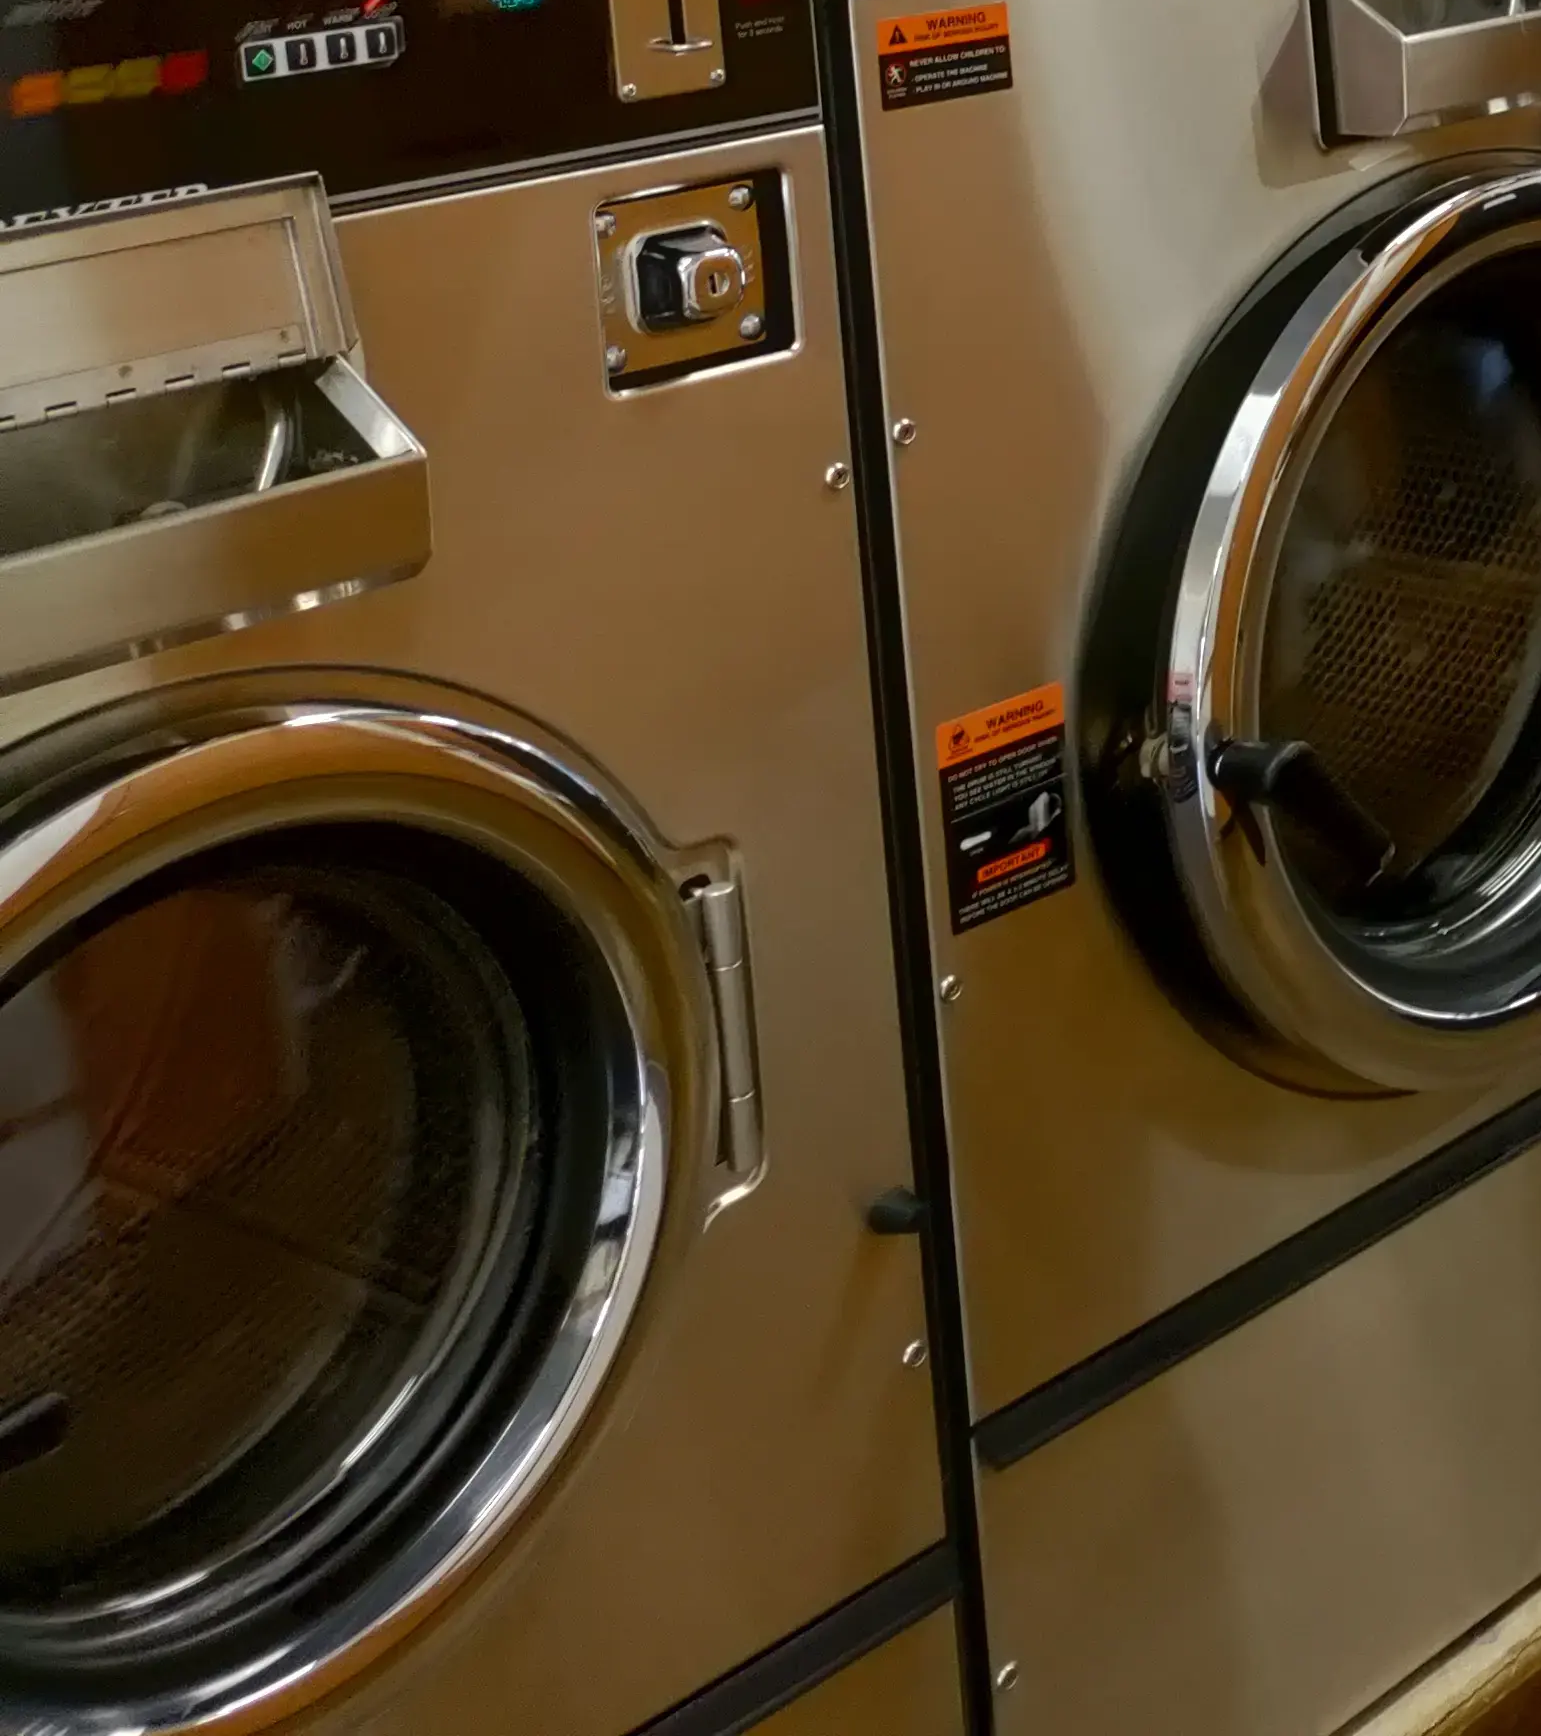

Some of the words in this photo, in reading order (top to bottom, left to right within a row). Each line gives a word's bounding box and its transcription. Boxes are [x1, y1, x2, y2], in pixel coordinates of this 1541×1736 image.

[926, 12, 986, 30] WARNING
[935, 53, 959, 63] ALLOW
[960, 47, 994, 59] CHILDREN
[914, 70, 945, 82] OPERATE
[915, 83, 932, 93] PLAY
[985, 700, 1044, 729] WARNING
[982, 847, 1040, 877] IMPORTANT
